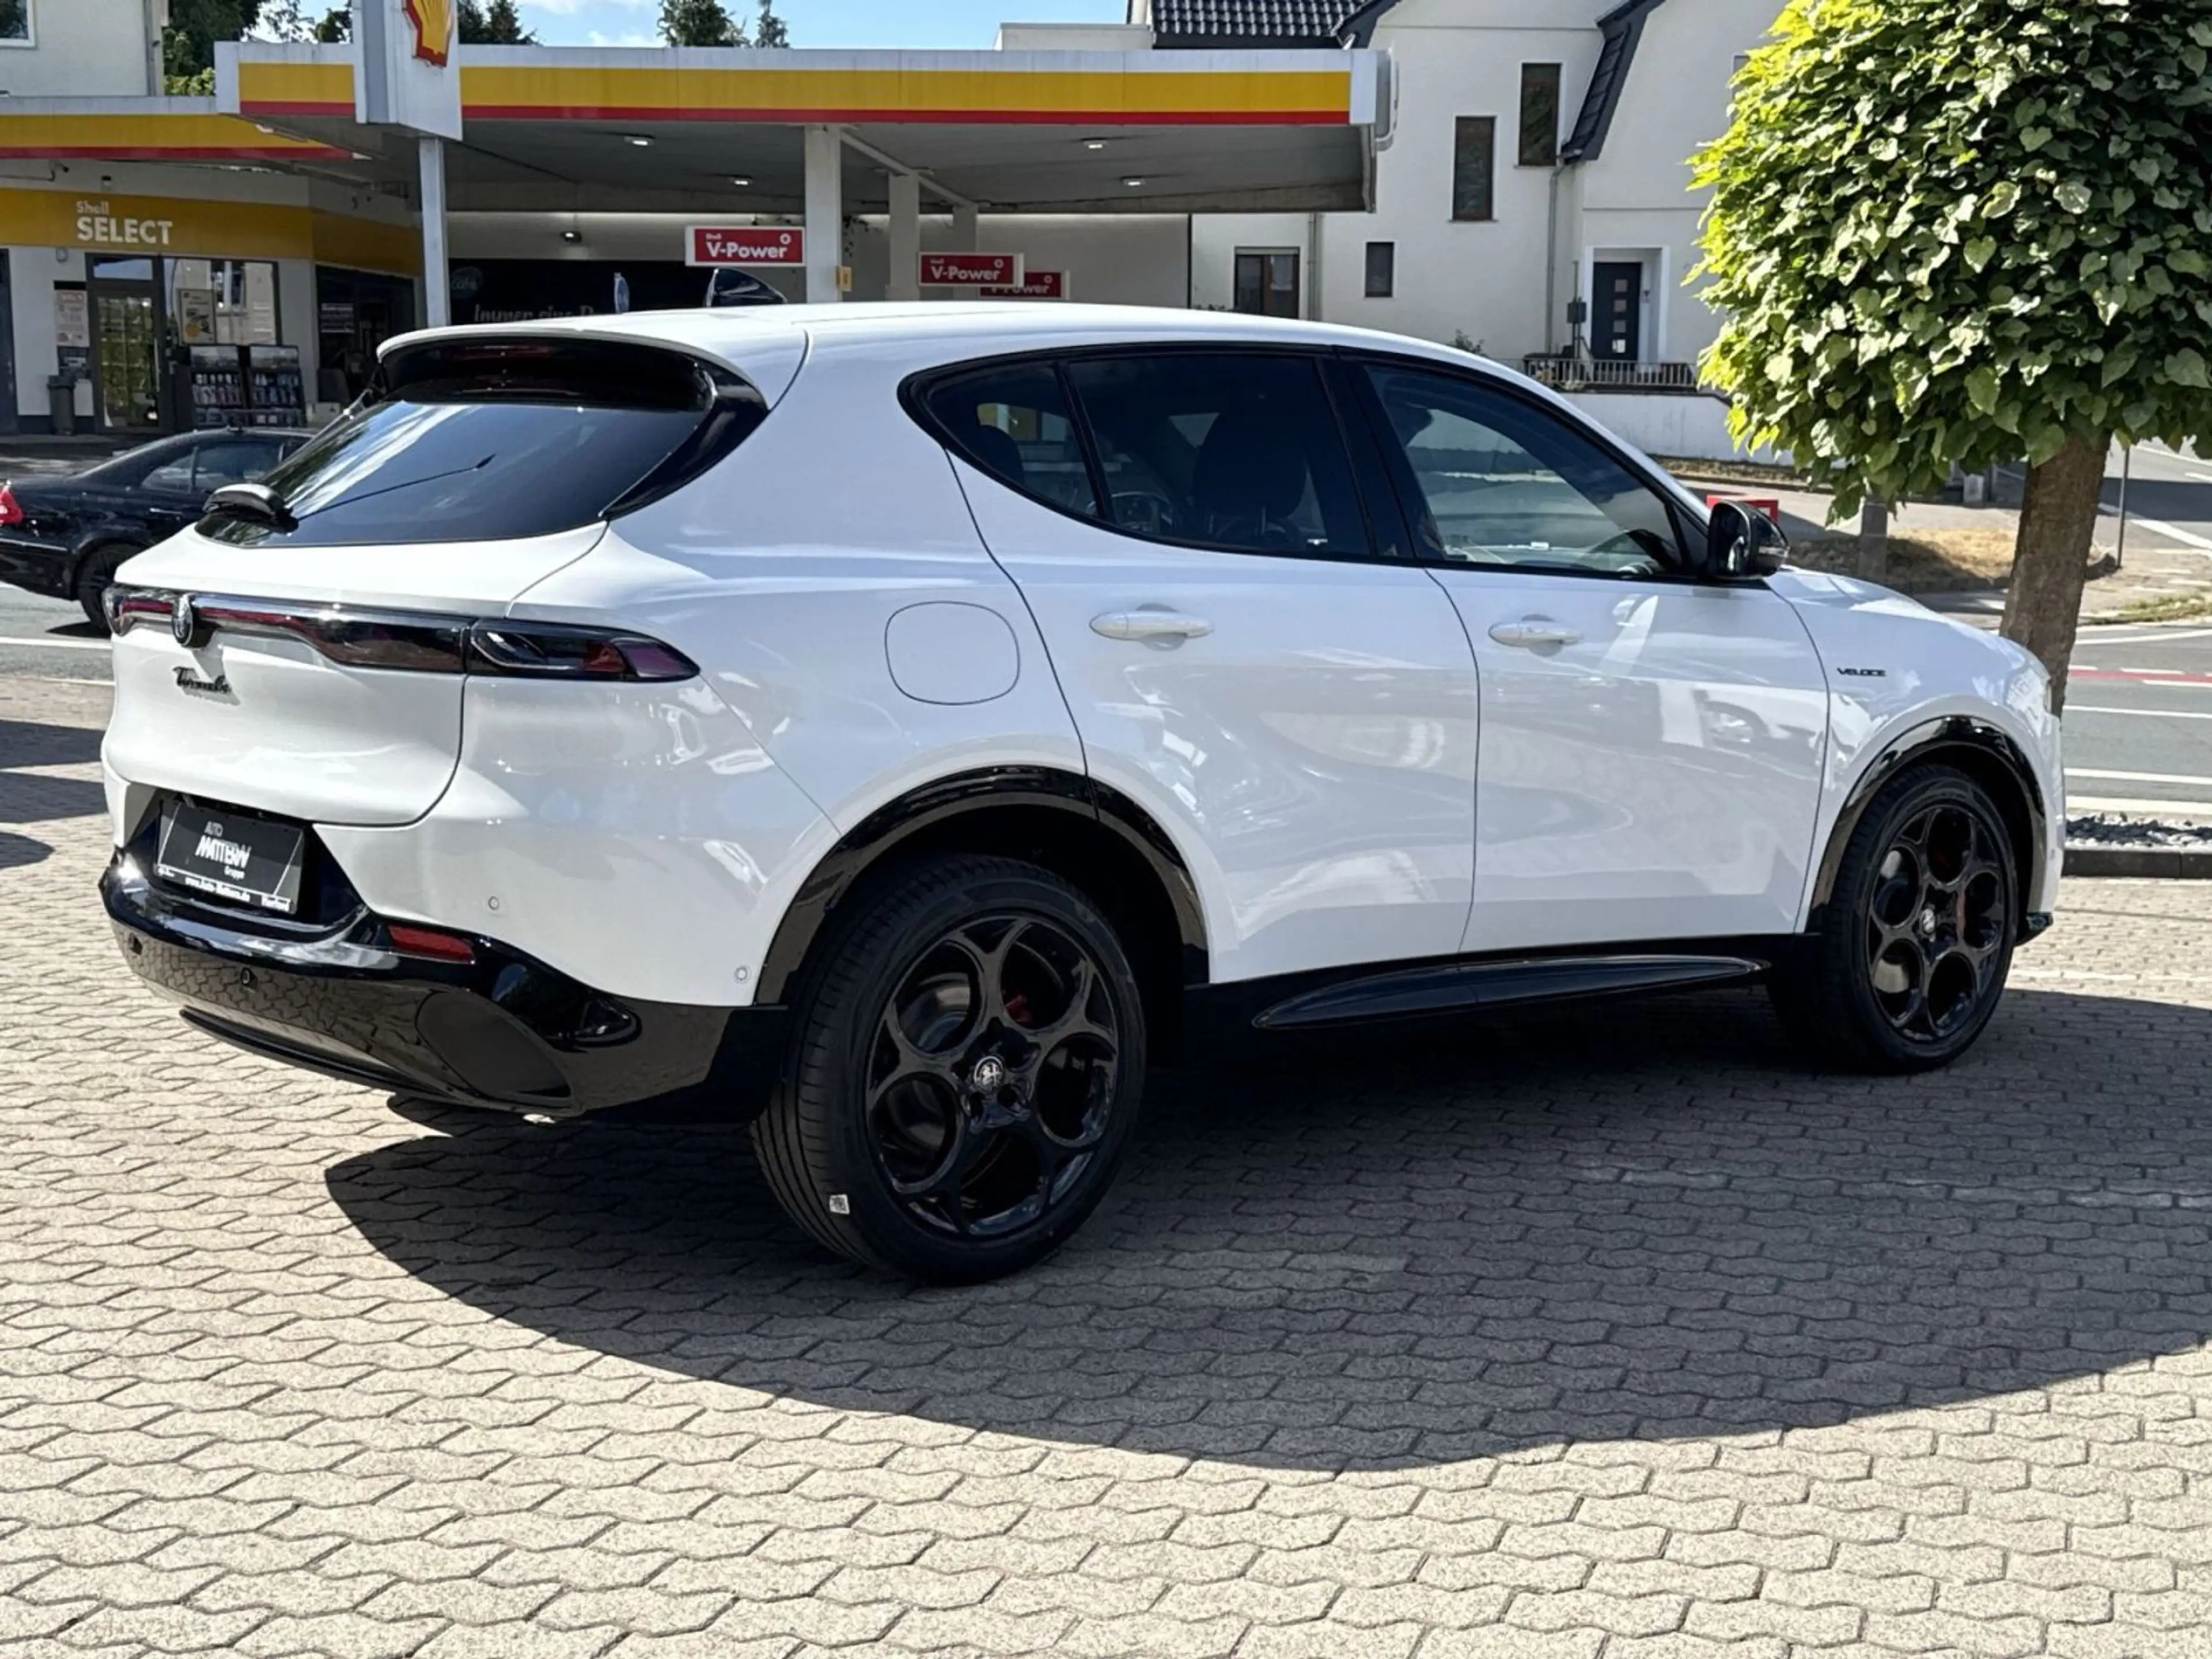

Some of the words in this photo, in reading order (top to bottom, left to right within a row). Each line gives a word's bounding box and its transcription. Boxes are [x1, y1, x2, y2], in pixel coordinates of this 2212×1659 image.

[77, 216, 173, 245] SELECT
[706, 242, 787, 259] V-Power
[931, 266, 1001, 280] V-Power
[1836, 667, 1887, 677] VELOCE
